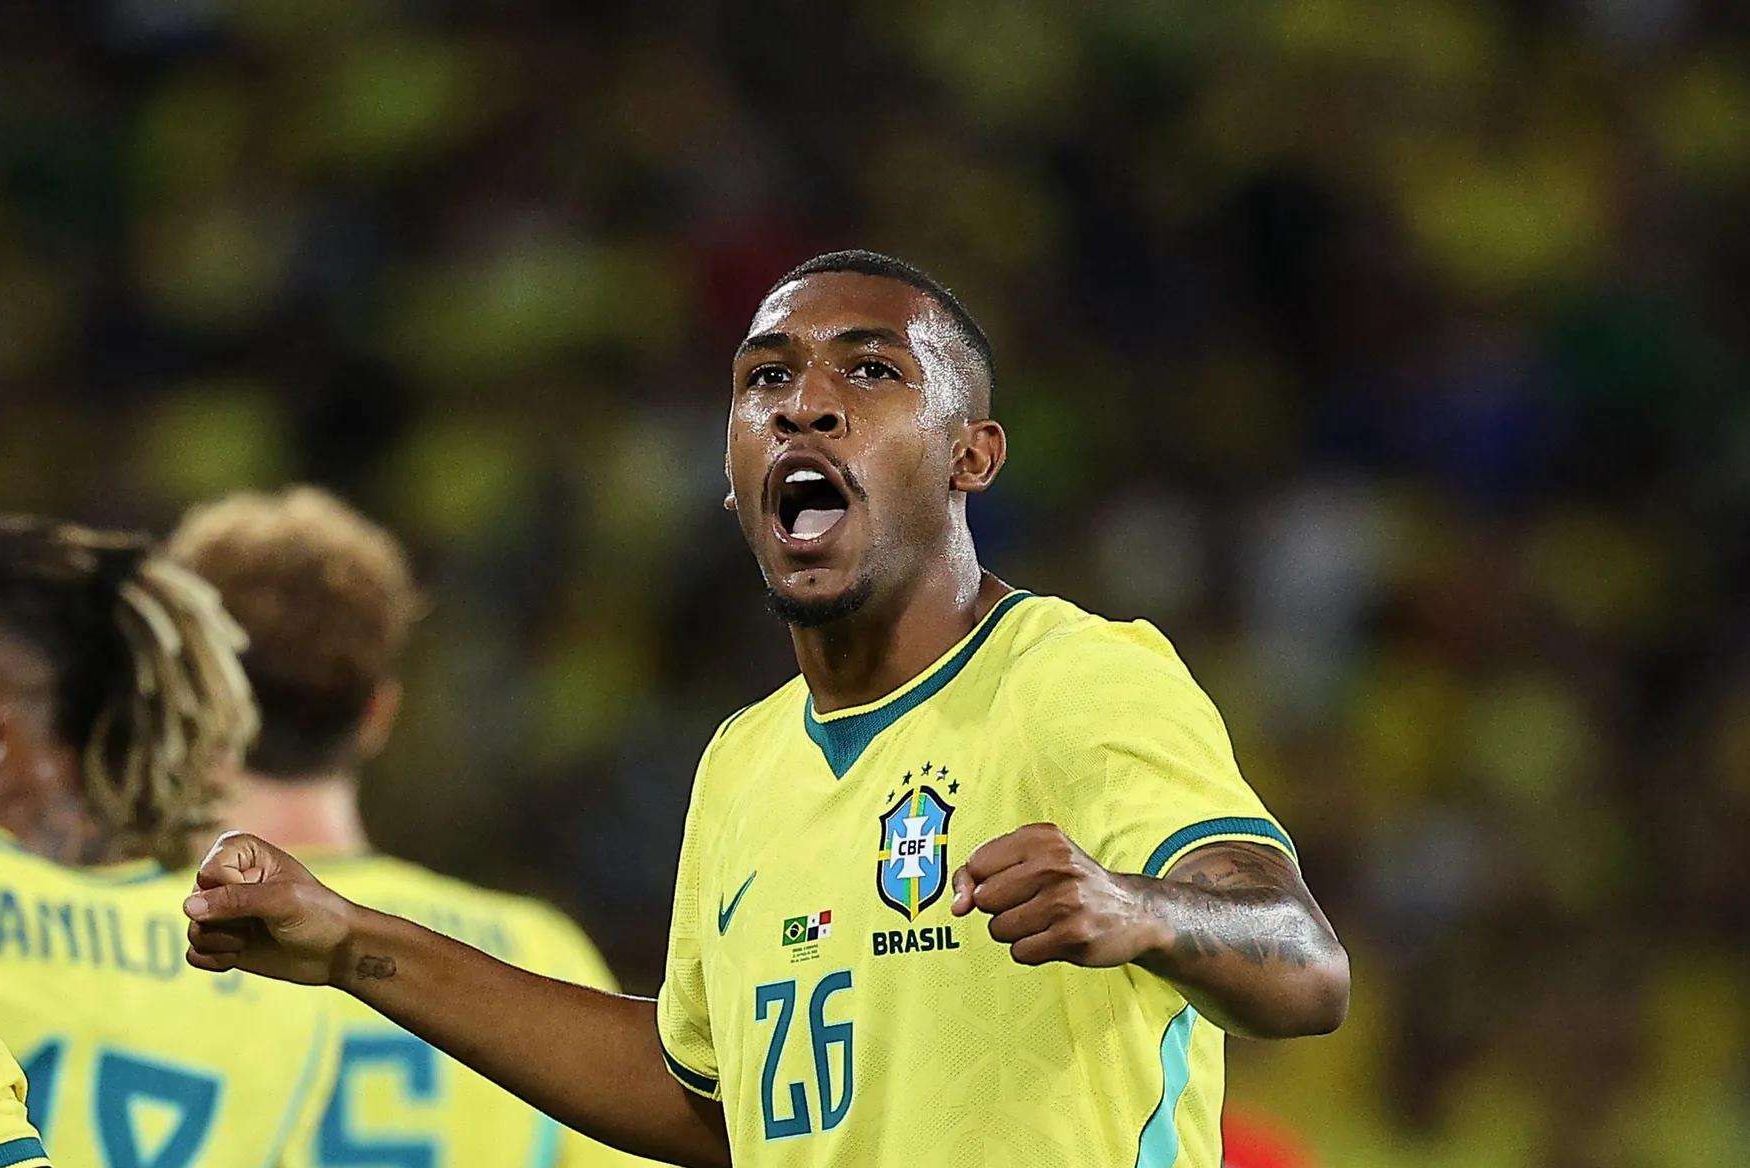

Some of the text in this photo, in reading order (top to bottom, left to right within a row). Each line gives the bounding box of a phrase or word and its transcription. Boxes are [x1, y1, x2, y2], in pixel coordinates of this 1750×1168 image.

[899, 839, 926, 855] CBF
[873, 926, 960, 956] BRASIL
[754, 968, 854, 1141] 26
